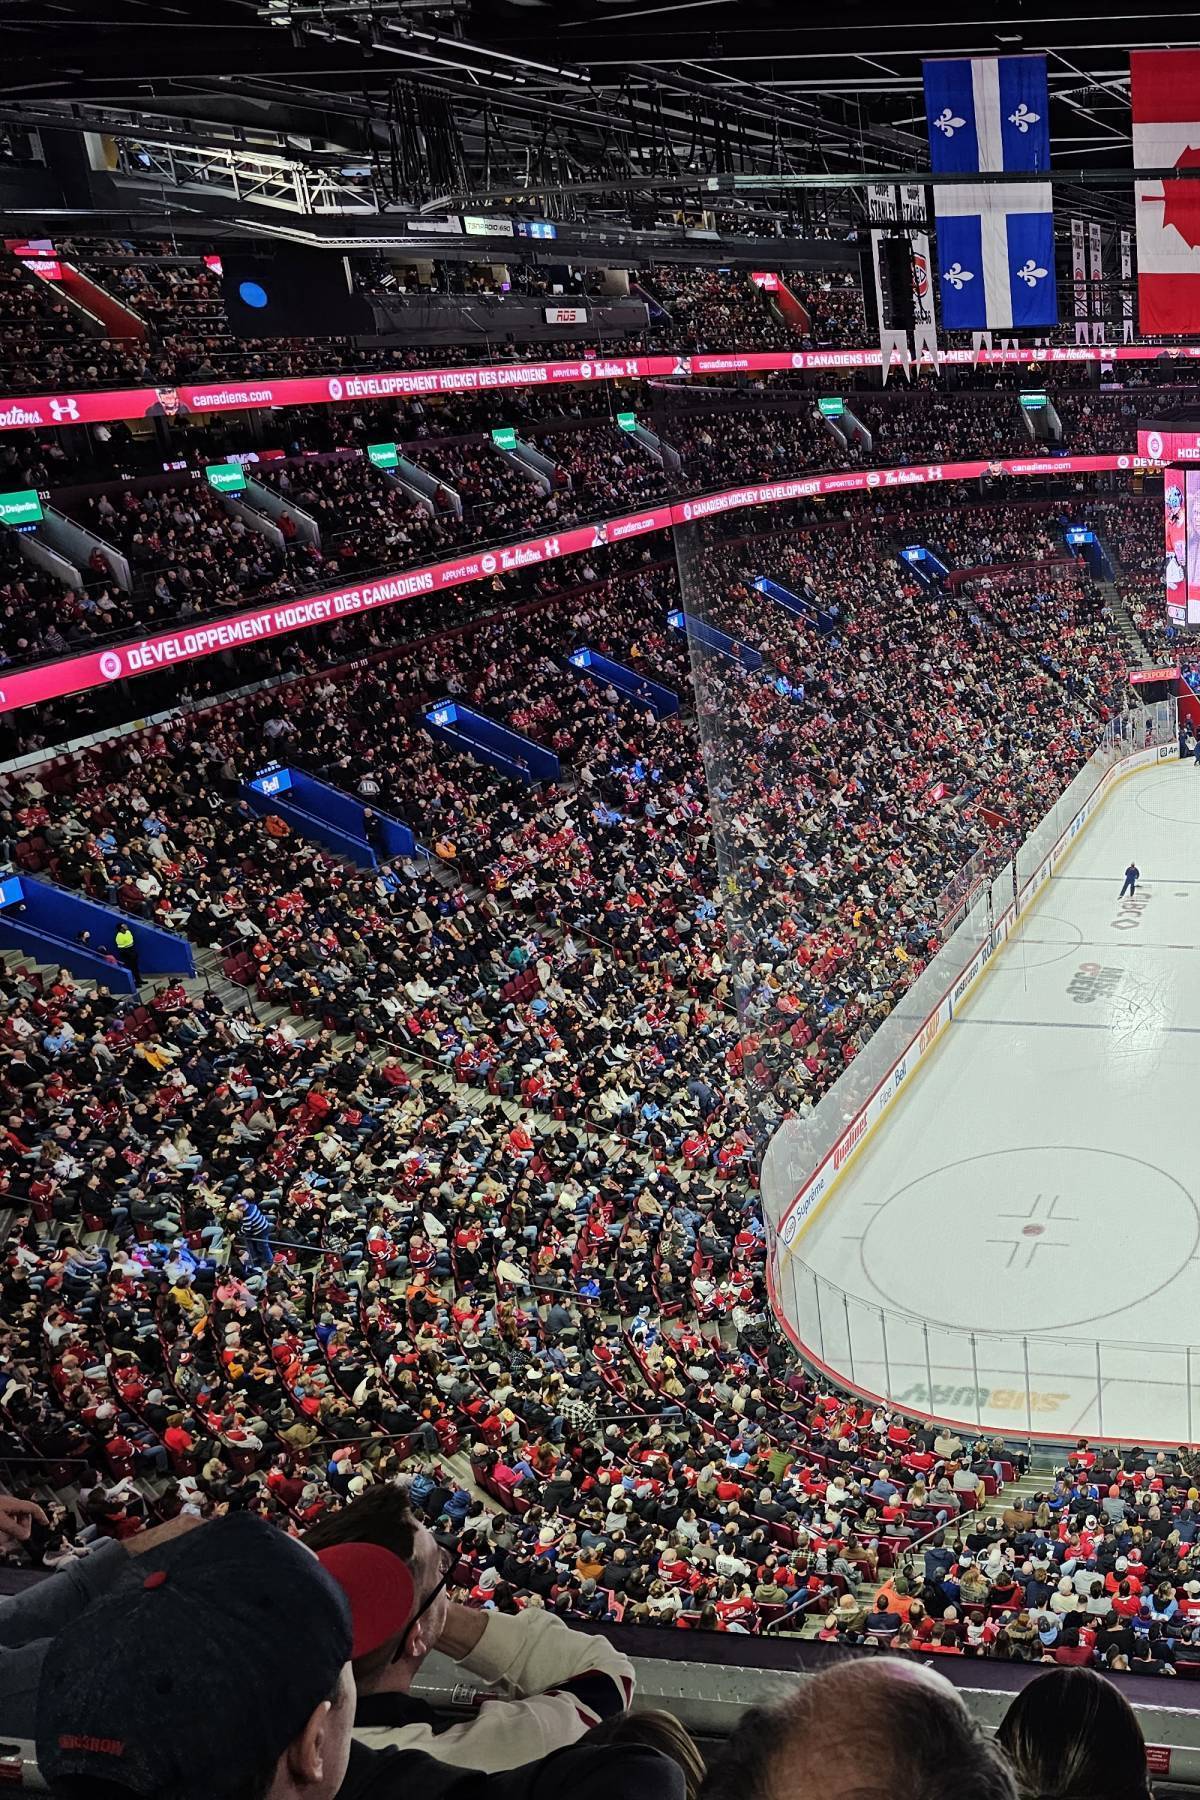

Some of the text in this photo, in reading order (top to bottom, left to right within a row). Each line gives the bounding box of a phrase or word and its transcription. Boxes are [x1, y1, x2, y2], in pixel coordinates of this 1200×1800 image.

[556, 310, 577, 322] RDS
[699, 358, 748, 370] canadiens.com
[807, 353, 863, 367] CANADIENS
[346, 366, 547, 397] DÉVELOPPEMENT HOCKEY DES CANADIENS
[193, 389, 273, 407] canadiens.com
[0, 406, 40, 426] ortons
[190, 471, 201, 479] 212
[1011, 461, 1071, 471] canadiens.com
[855, 479, 863, 487] BY
[885, 472, 898, 485] Tim
[38, 491, 51, 500] 212
[693, 481, 821, 516] CANADIENS HOCKEY DEVELOPMENT
[501, 548, 542, 569] Tim Hortons
[441, 564, 479, 582] APPUYÉ PAR
[127, 573, 434, 671] DÉVELOPPEMENT HOCKEY DES CANADIENS
[262, 776, 280, 793] Bell
[894, 1060, 907, 1088] Bell
[832, 1110, 869, 1171] Qualinet
[892, 1382, 1071, 1413] SUBWAY
